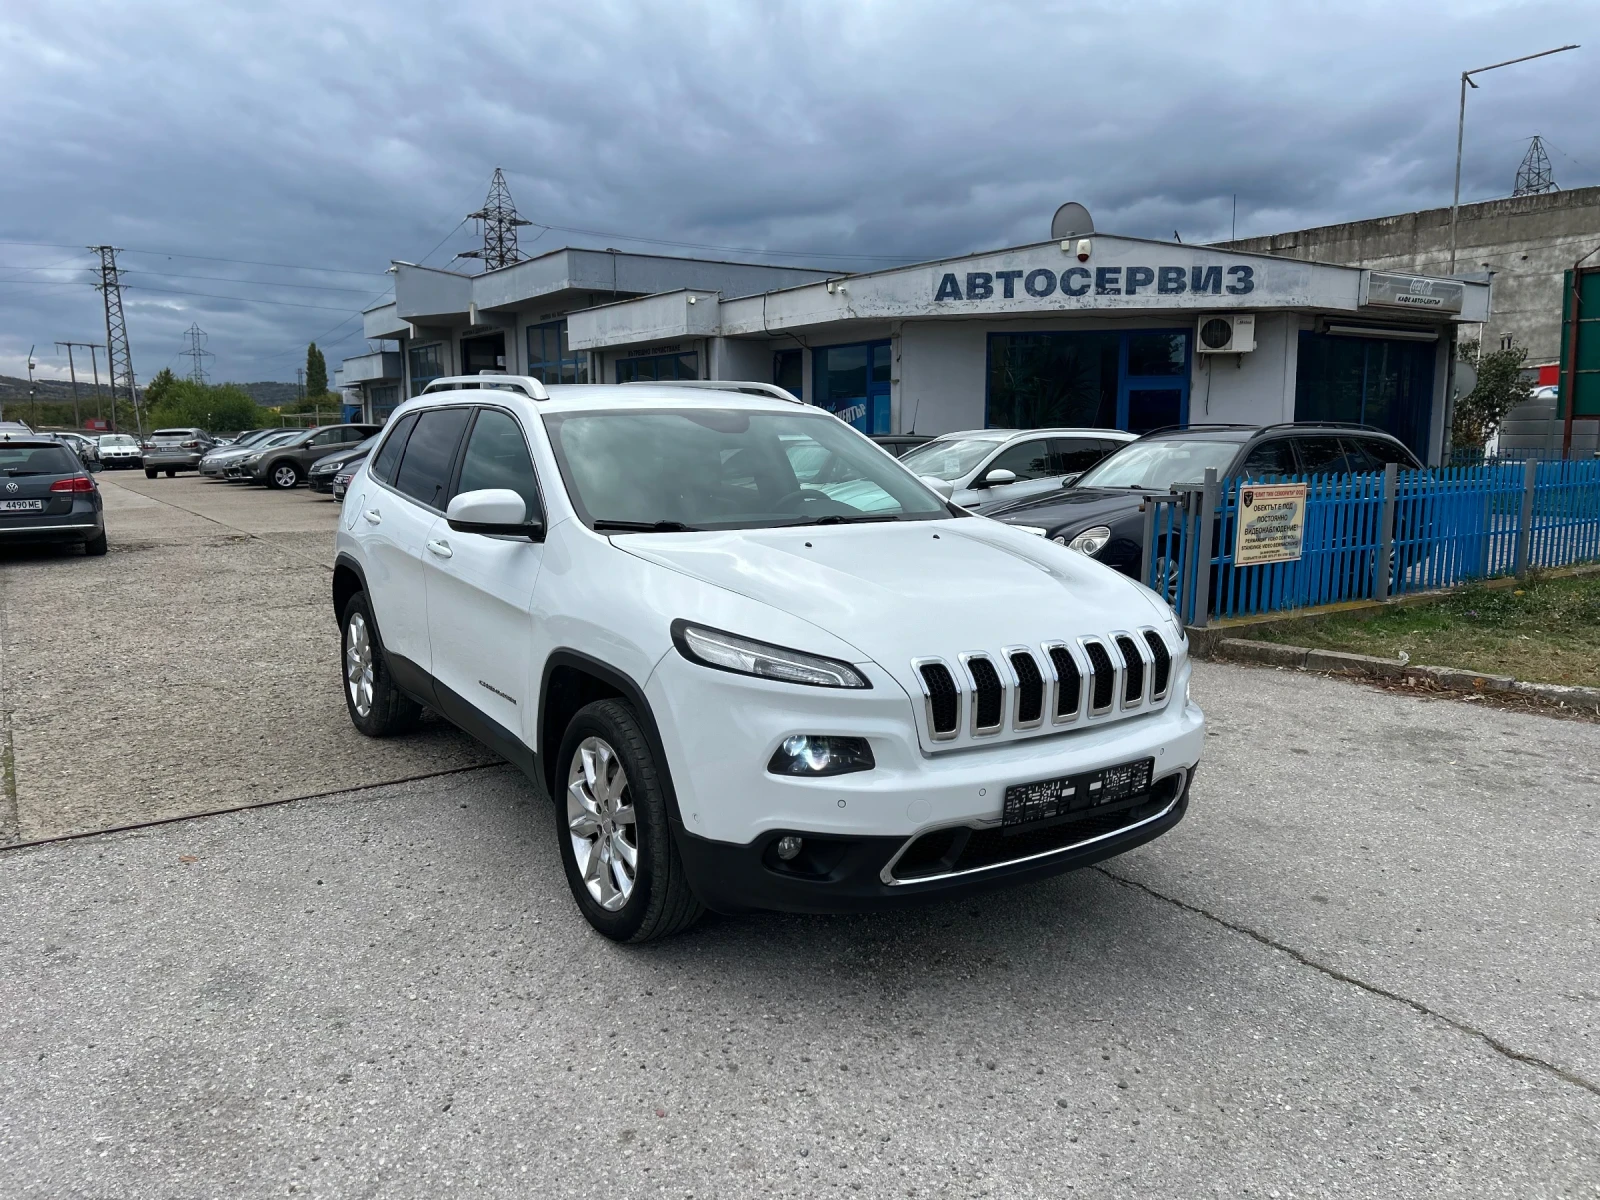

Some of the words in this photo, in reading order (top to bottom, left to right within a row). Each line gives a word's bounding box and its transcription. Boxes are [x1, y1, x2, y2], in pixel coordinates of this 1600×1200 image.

[934, 265, 1255, 301] АВТОСЕРВИЗ
[1411, 297, 1440, 305] АВТО-ЦЕНТЪР
[6, 501, 27, 509] 4490
[28, 500, 40, 509] ME
[1282, 502, 1294, 510] ПОД
[1257, 515, 1288, 523] ПОСТОЯННО
